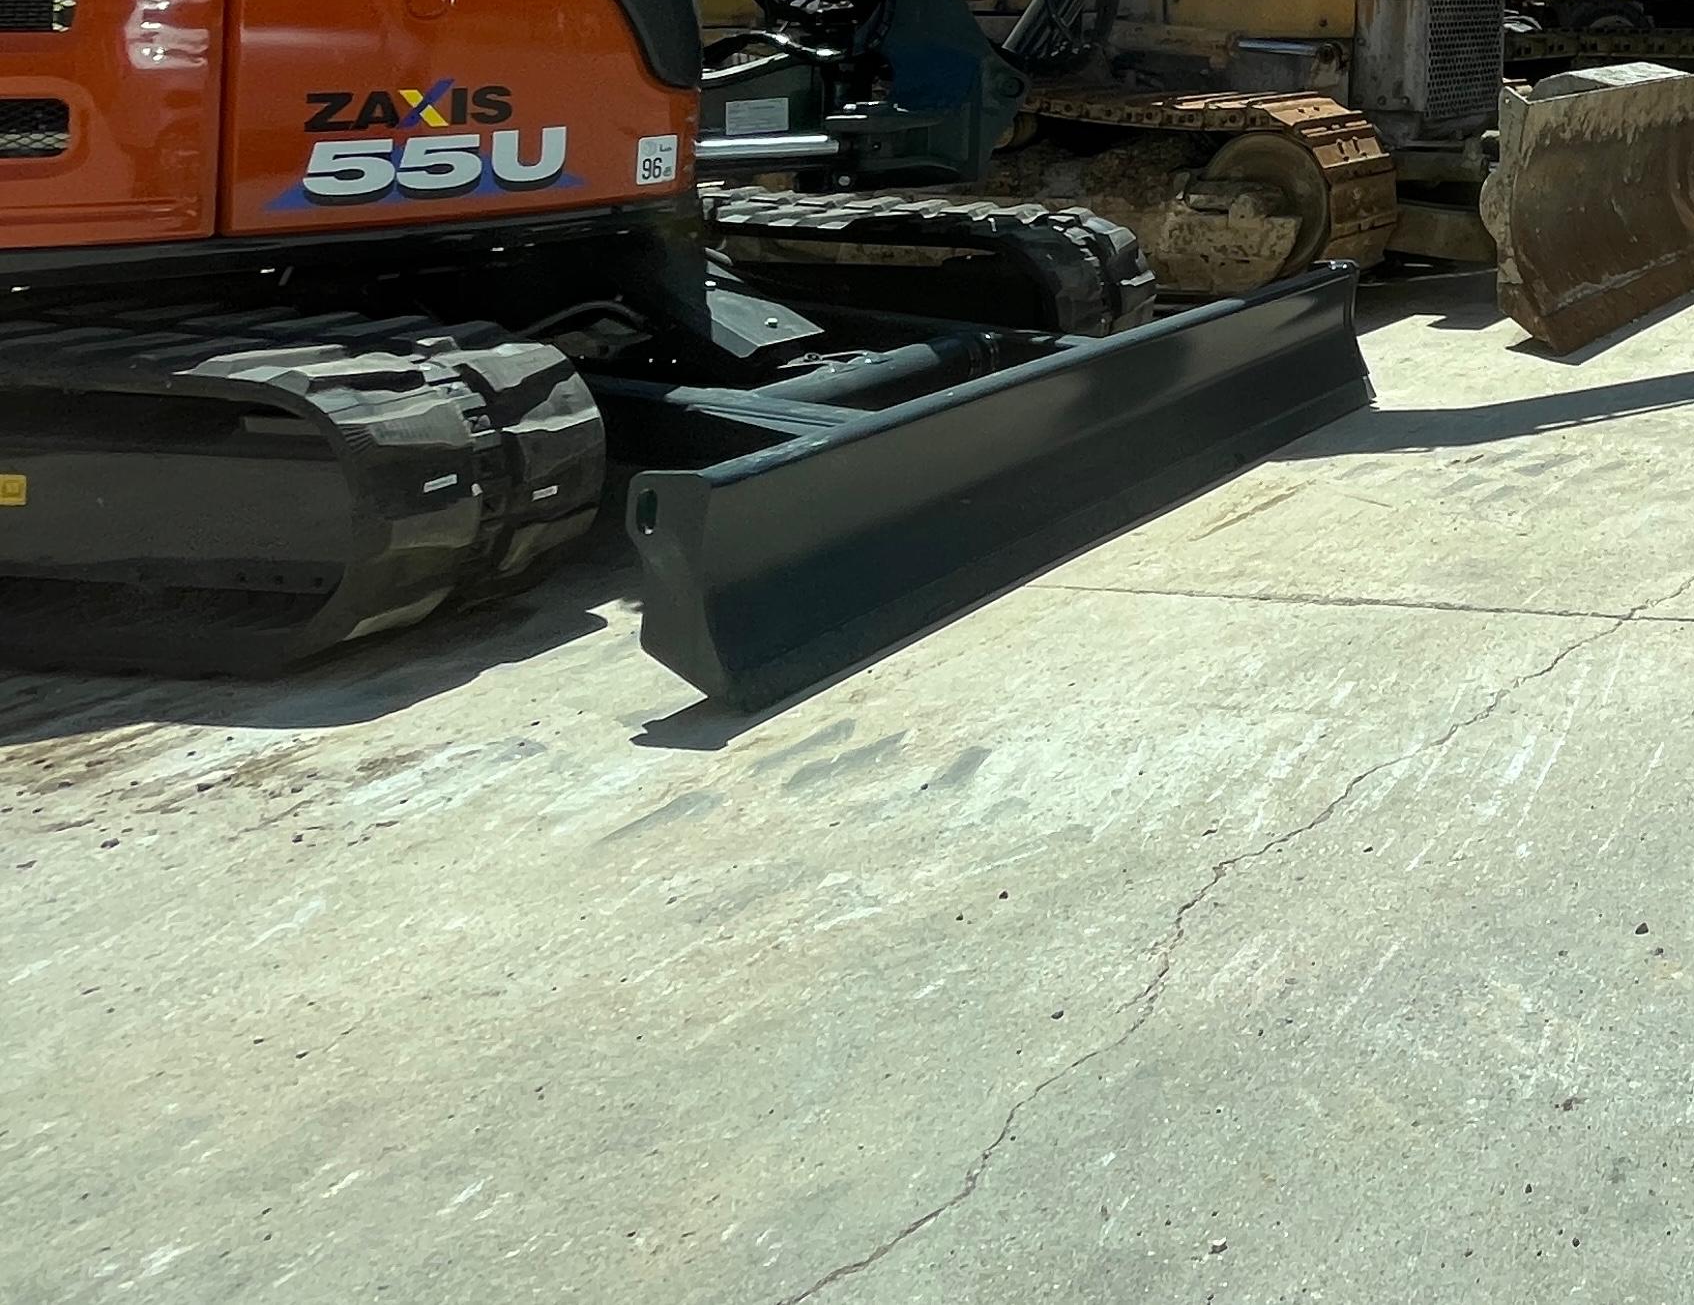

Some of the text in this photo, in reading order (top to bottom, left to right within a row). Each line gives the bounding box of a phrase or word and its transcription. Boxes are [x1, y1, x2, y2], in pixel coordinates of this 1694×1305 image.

[304, 78, 514, 132] ZAXIS
[303, 126, 568, 200] 55U
[642, 157, 663, 180] 96
